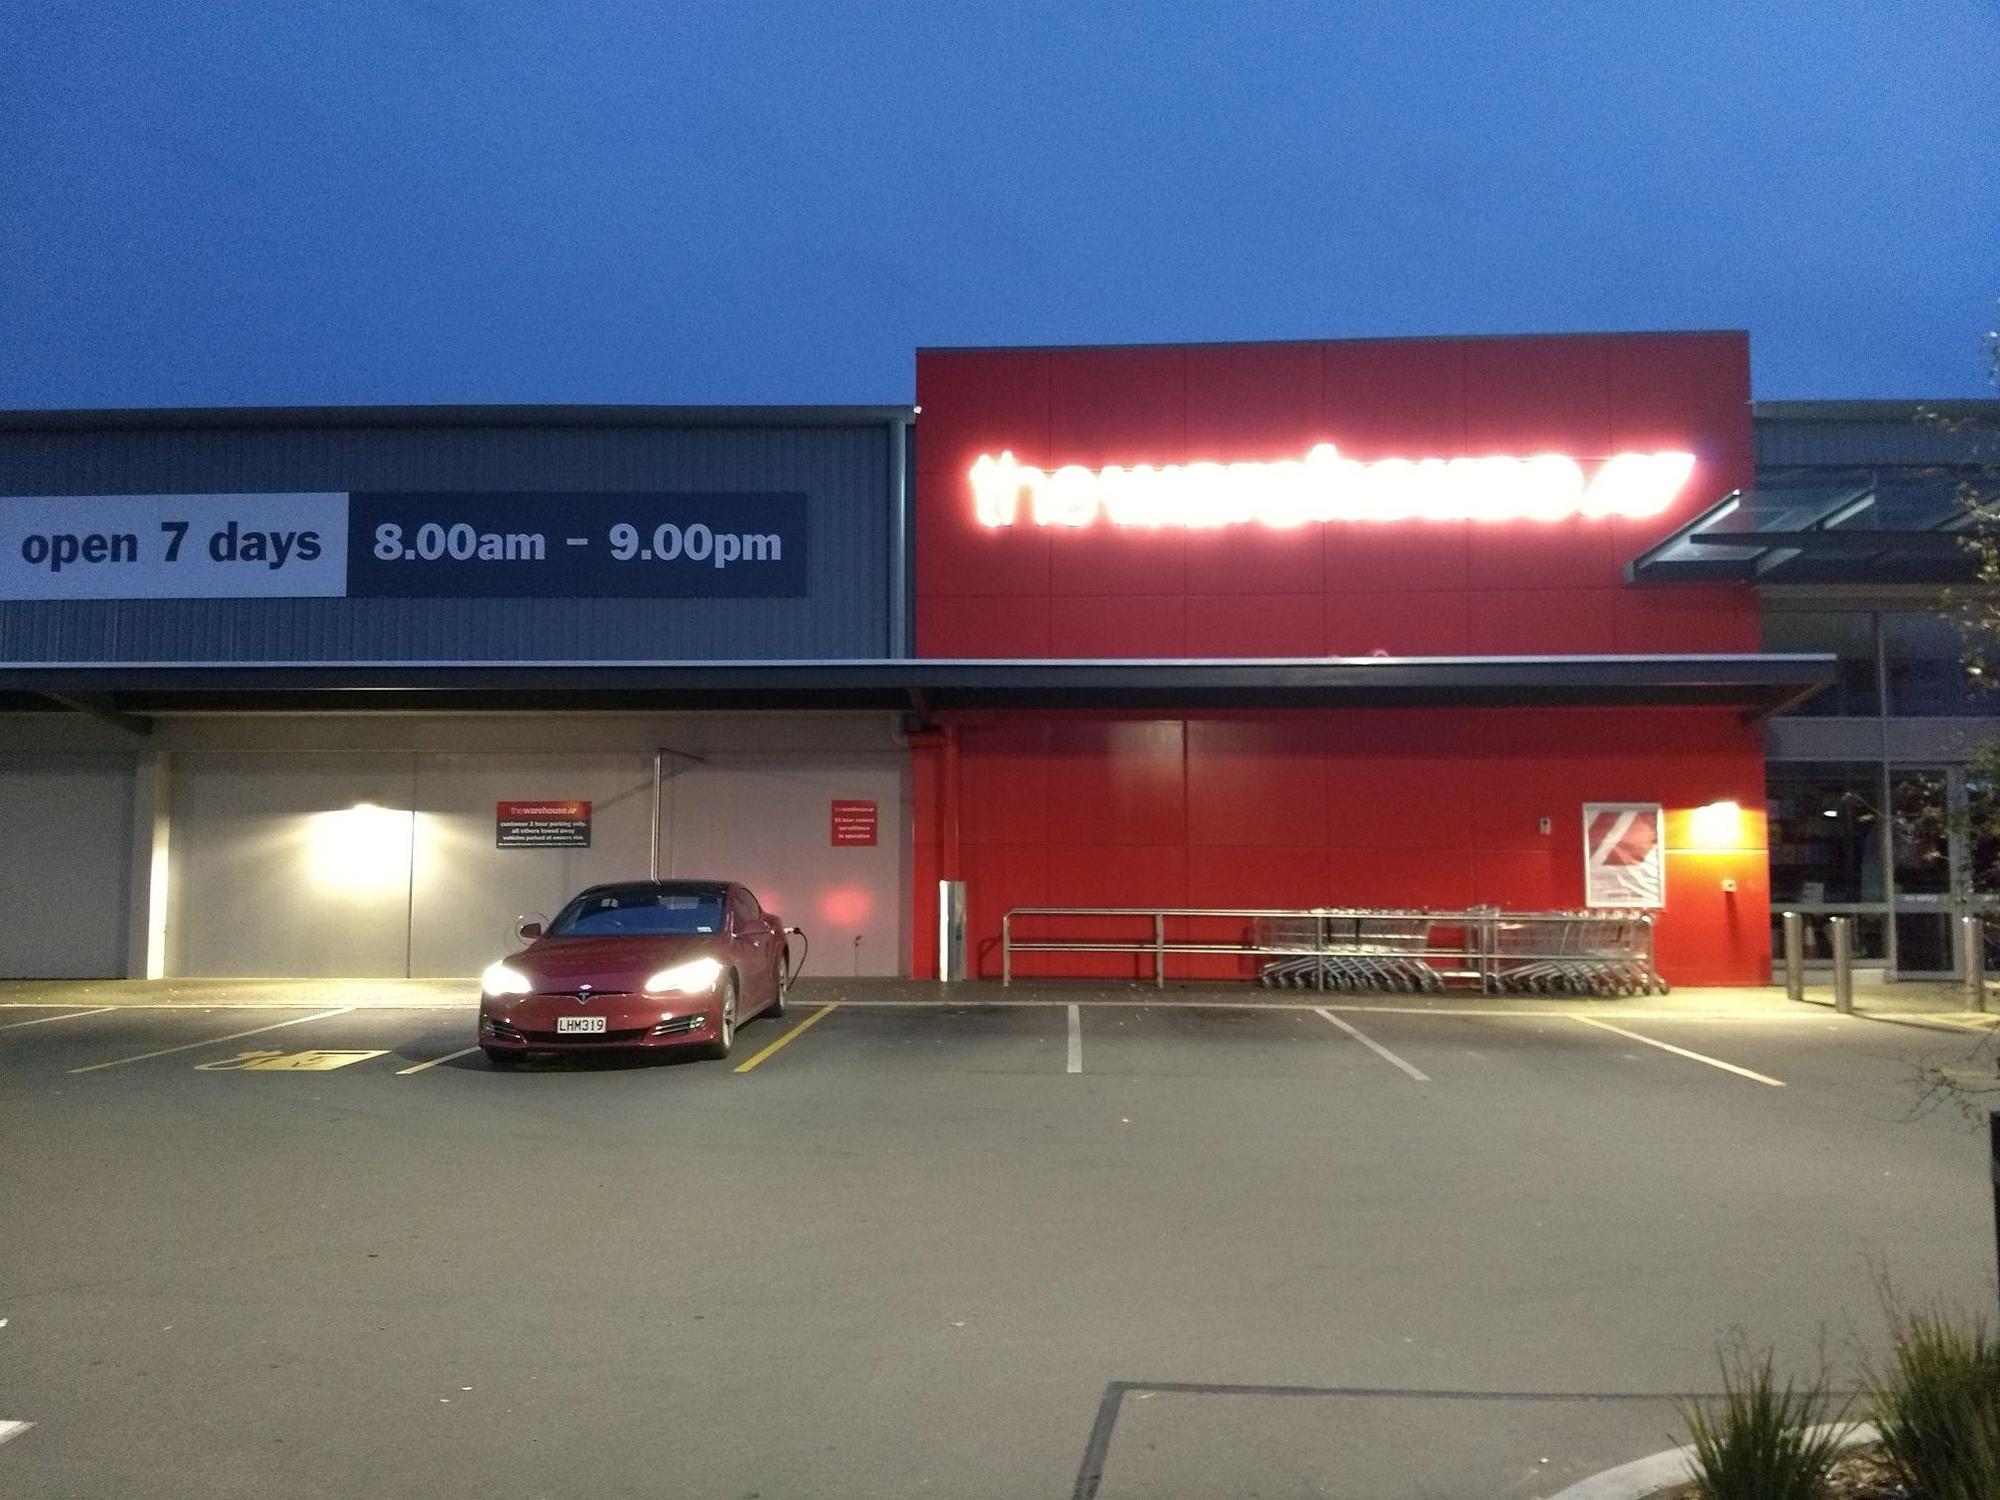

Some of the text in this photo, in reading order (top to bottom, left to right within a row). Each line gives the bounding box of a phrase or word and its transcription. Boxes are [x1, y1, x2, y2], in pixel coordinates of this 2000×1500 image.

[21, 521, 322, 572] open 7 days
[373, 523, 546, 561] 8.00am
[608, 523, 782, 569] 9.00pm
[559, 1019, 604, 1031] LHM319
